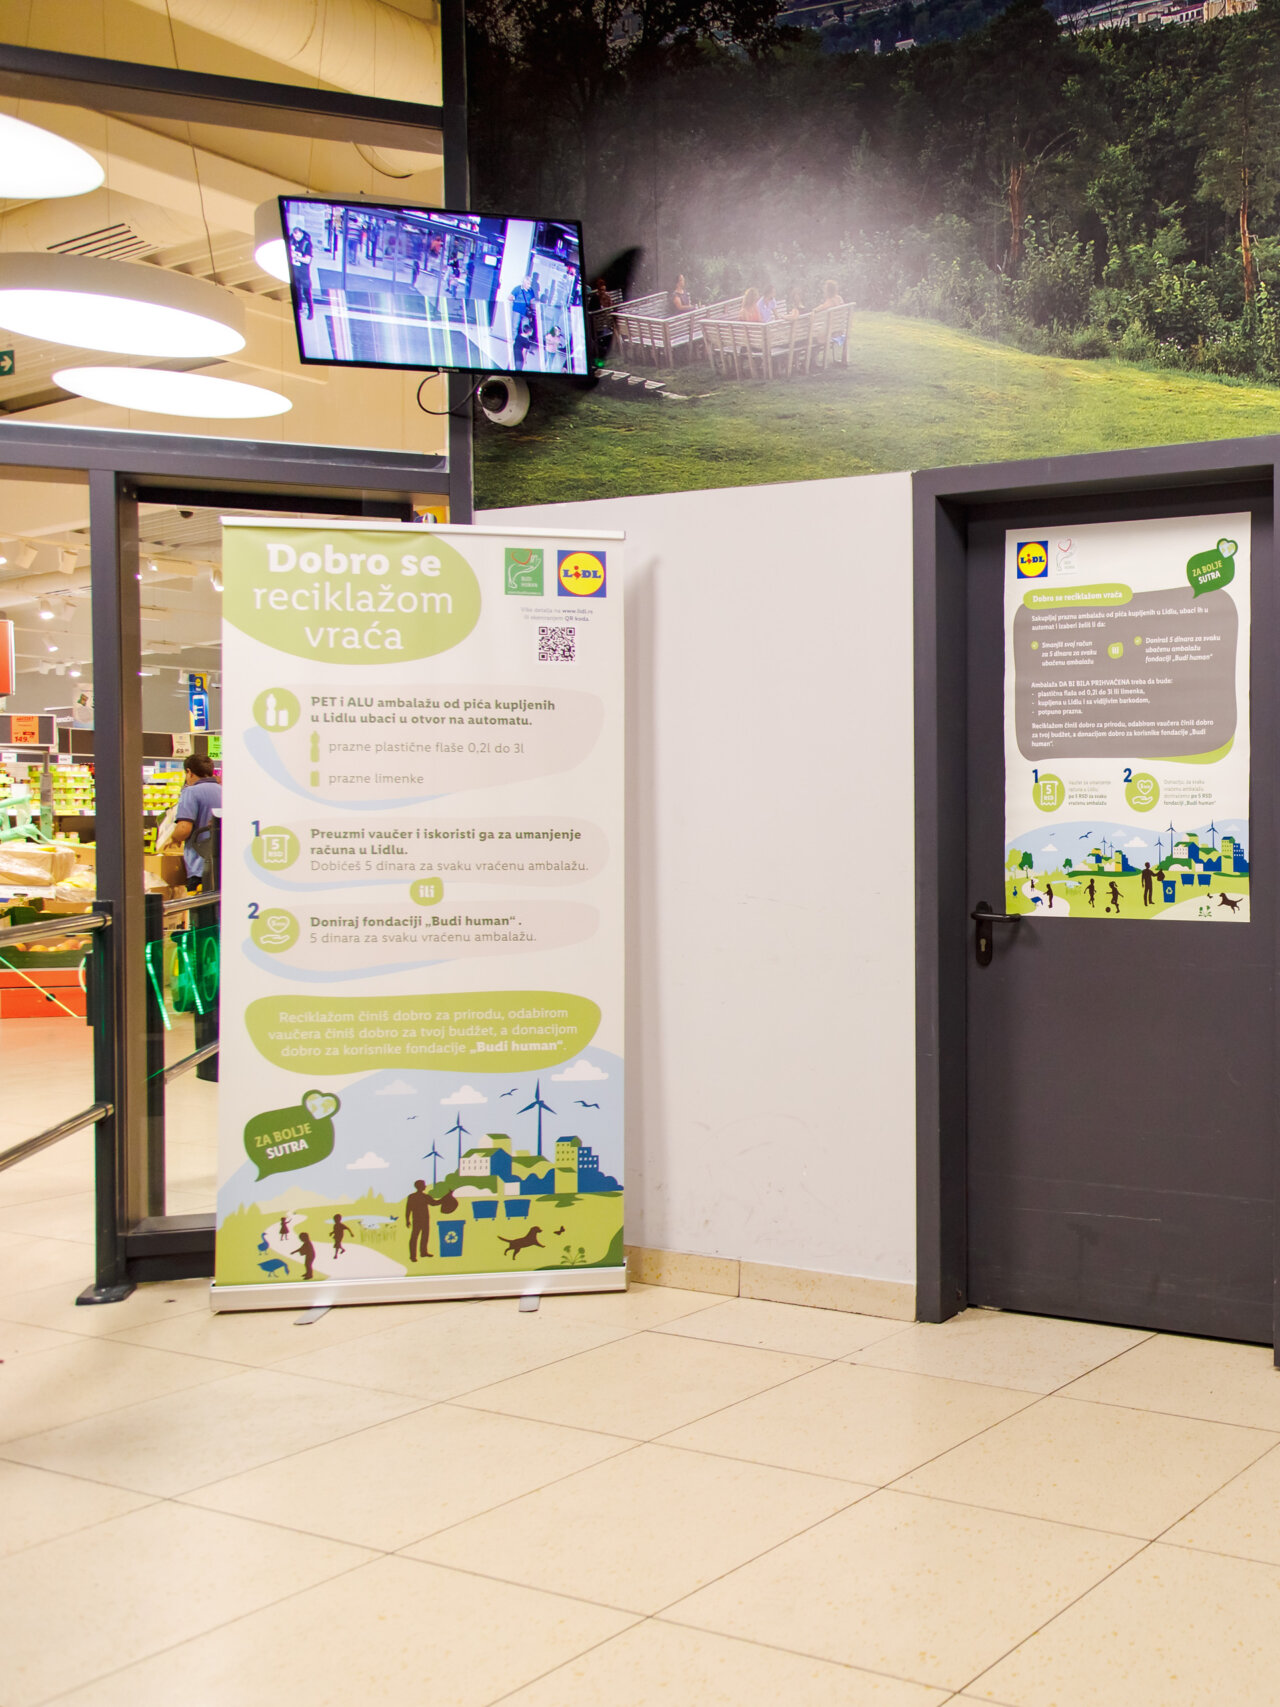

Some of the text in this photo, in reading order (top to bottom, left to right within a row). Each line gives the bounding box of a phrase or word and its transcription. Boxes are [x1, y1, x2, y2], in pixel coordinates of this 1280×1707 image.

[267, 543, 441, 576] Dobro se
[1191, 561, 1222, 576] ZA BOLJE
[1198, 572, 1220, 584] SUTRA
[254, 582, 452, 612] reciklažom
[304, 623, 403, 649] vraća
[311, 696, 555, 711] PET i ALU ambalažu od pića kupljenih
[310, 714, 320, 722] u
[323, 712, 357, 722] Lidlu
[360, 712, 396, 723] ubaci
[410, 715, 446, 724] otvor
[448, 716, 465, 724] na
[467, 716, 532, 725] automatu.
[328, 741, 525, 753] prazne plastične flaše 0,2l do 3l
[328, 773, 424, 785] prazne limenke
[1032, 768, 1038, 783] 1
[1123, 767, 1132, 782] 2
[251, 820, 261, 837] 1
[310, 828, 581, 841] Preuzmi vaučer i iskoristi ga za umanjenje
[310, 844, 356, 854] računa
[370, 844, 408, 854] Lidlu.
[310, 860, 589, 870] Dobićeš 5 dinara za svaku vraćenu ambalažu.
[418, 884, 435, 897] ili
[247, 902, 260, 919] 2
[310, 916, 359, 928] Doniraj
[362, 915, 422, 928] fondaciji
[310, 931, 537, 943] 5 dinara za svaku vraćenu ambalažu.
[279, 1007, 569, 1022] Reciklažom činiš dobro za prirodu, odabirom
[267, 1023, 578, 1040] vaučera činiš dobro za tvoj budžet, a donacijom
[281, 1045, 322, 1056] dobro
[324, 1047, 340, 1055] za
[343, 1043, 402, 1055] korisnike
[405, 1042, 466, 1054] fondacije
[254, 1123, 312, 1147] ZA BOLJE
[266, 1139, 308, 1158] SUTRA
